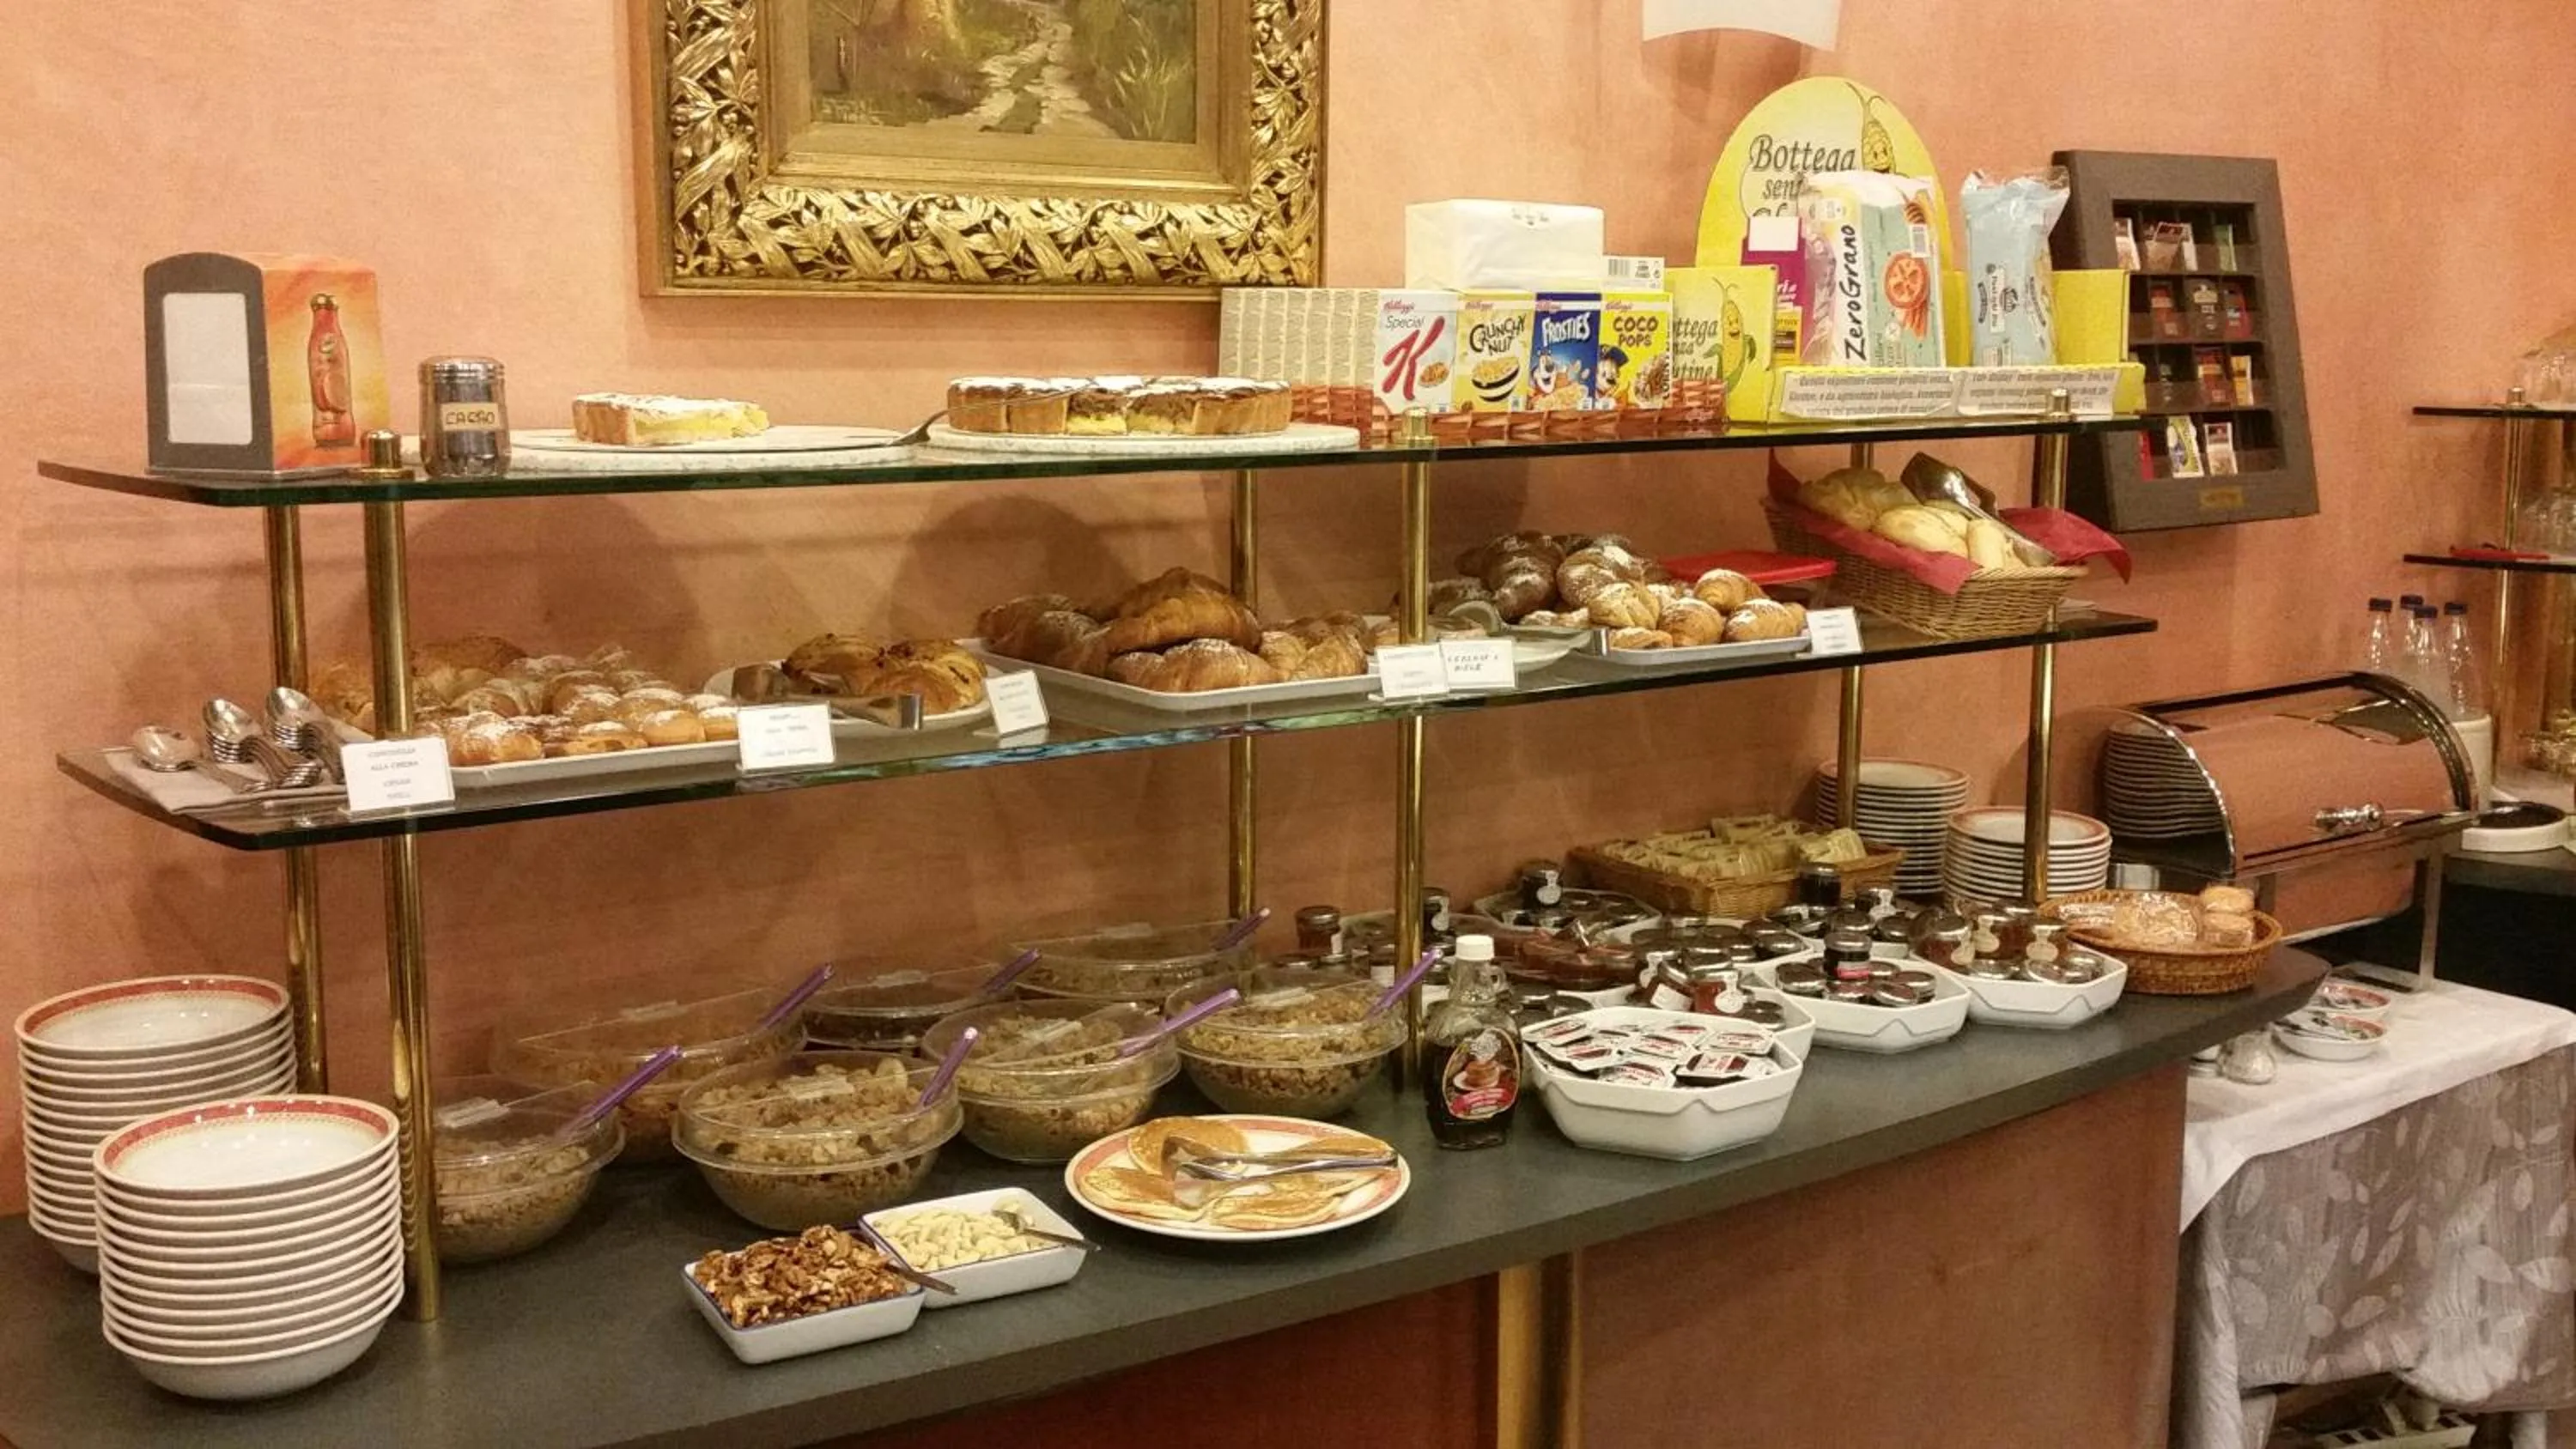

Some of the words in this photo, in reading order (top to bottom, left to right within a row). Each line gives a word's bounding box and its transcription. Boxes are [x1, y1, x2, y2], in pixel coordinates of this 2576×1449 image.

[1749, 134, 1857, 173] Bottega
[1839, 224, 1867, 361] ZeroGrano
[1386, 315, 1425, 330] Special
[1469, 312, 1526, 353] CRUNCHY
[1541, 312, 1591, 347] FROSTIES
[1613, 316, 1658, 333] COCO
[1488, 336, 1514, 356] NUT
[1619, 334, 1652, 348] POPS
[1382, 316, 1445, 401] K
[446, 410, 495, 426] CACAO
